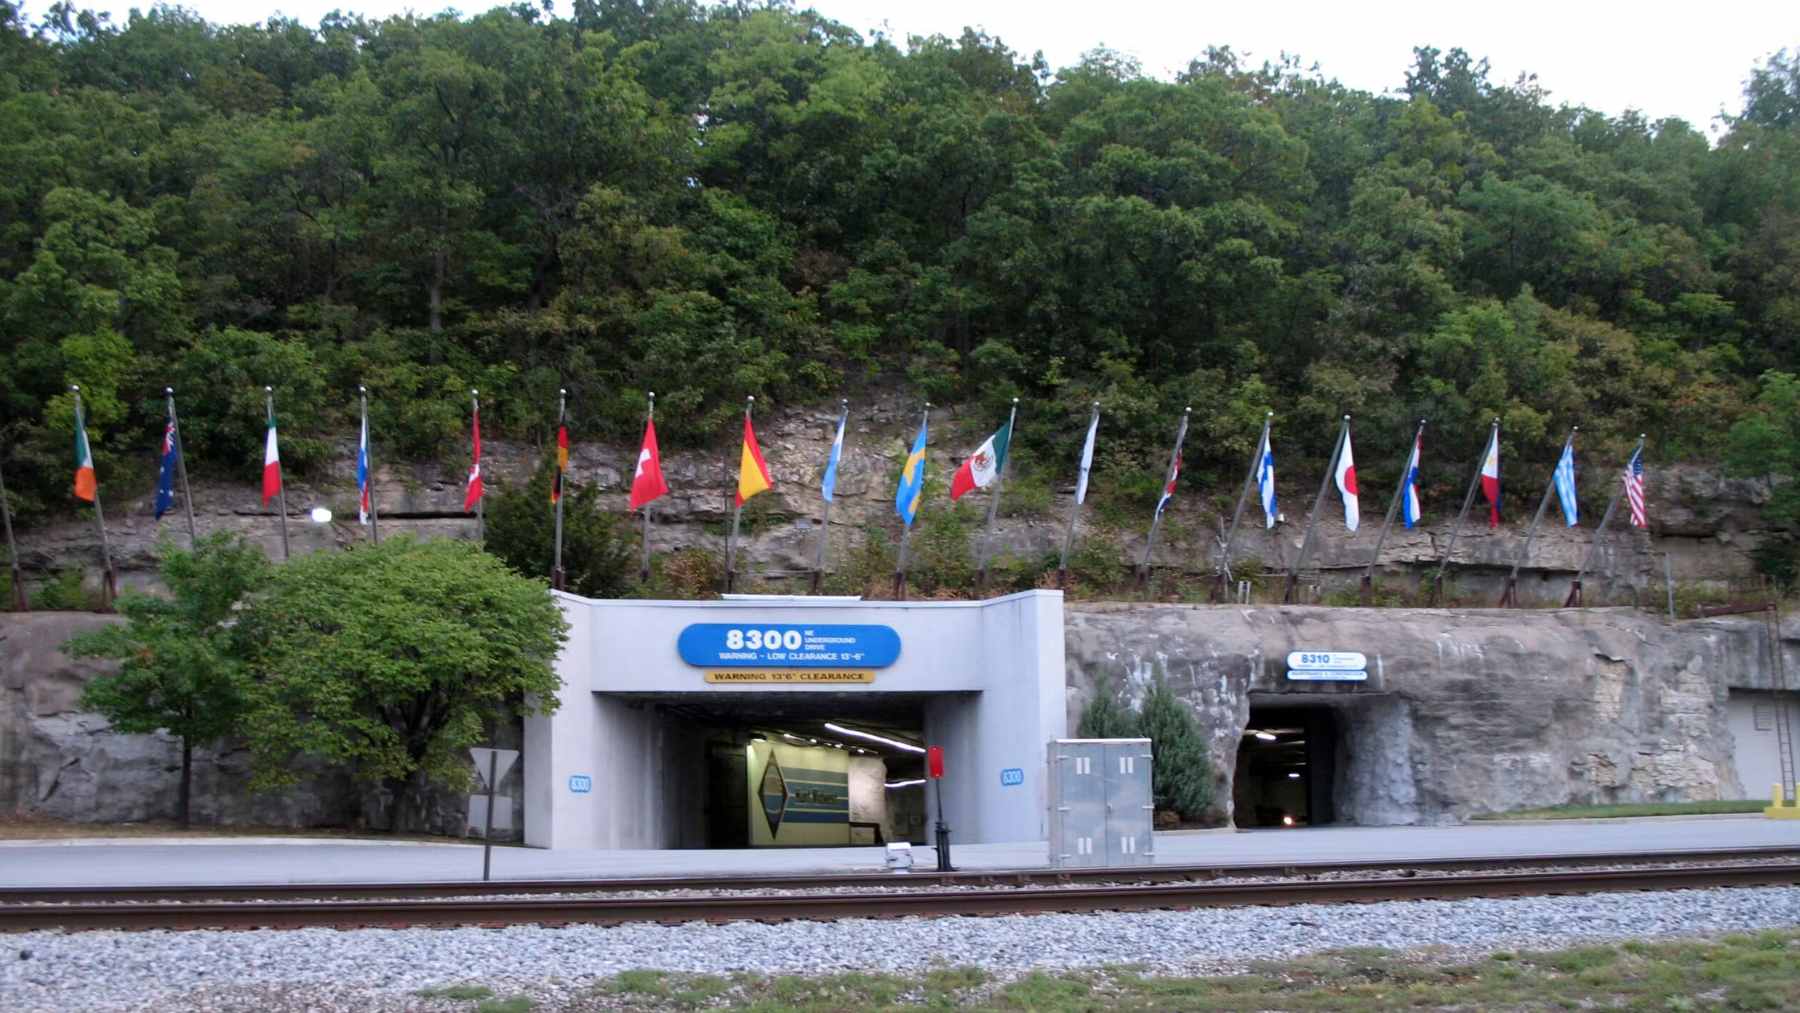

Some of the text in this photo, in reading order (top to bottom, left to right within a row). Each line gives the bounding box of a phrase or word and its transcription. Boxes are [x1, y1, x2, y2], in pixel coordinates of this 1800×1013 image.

[725, 629, 802, 650] 8300
[719, 652, 757, 660] WARNING
[767, 652, 786, 660] LOW
[788, 652, 838, 661] CLEARANCE
[1302, 654, 1330, 663] 8310
[714, 672, 766, 680] WARNING
[800, 672, 865, 680] CLEARANCE
